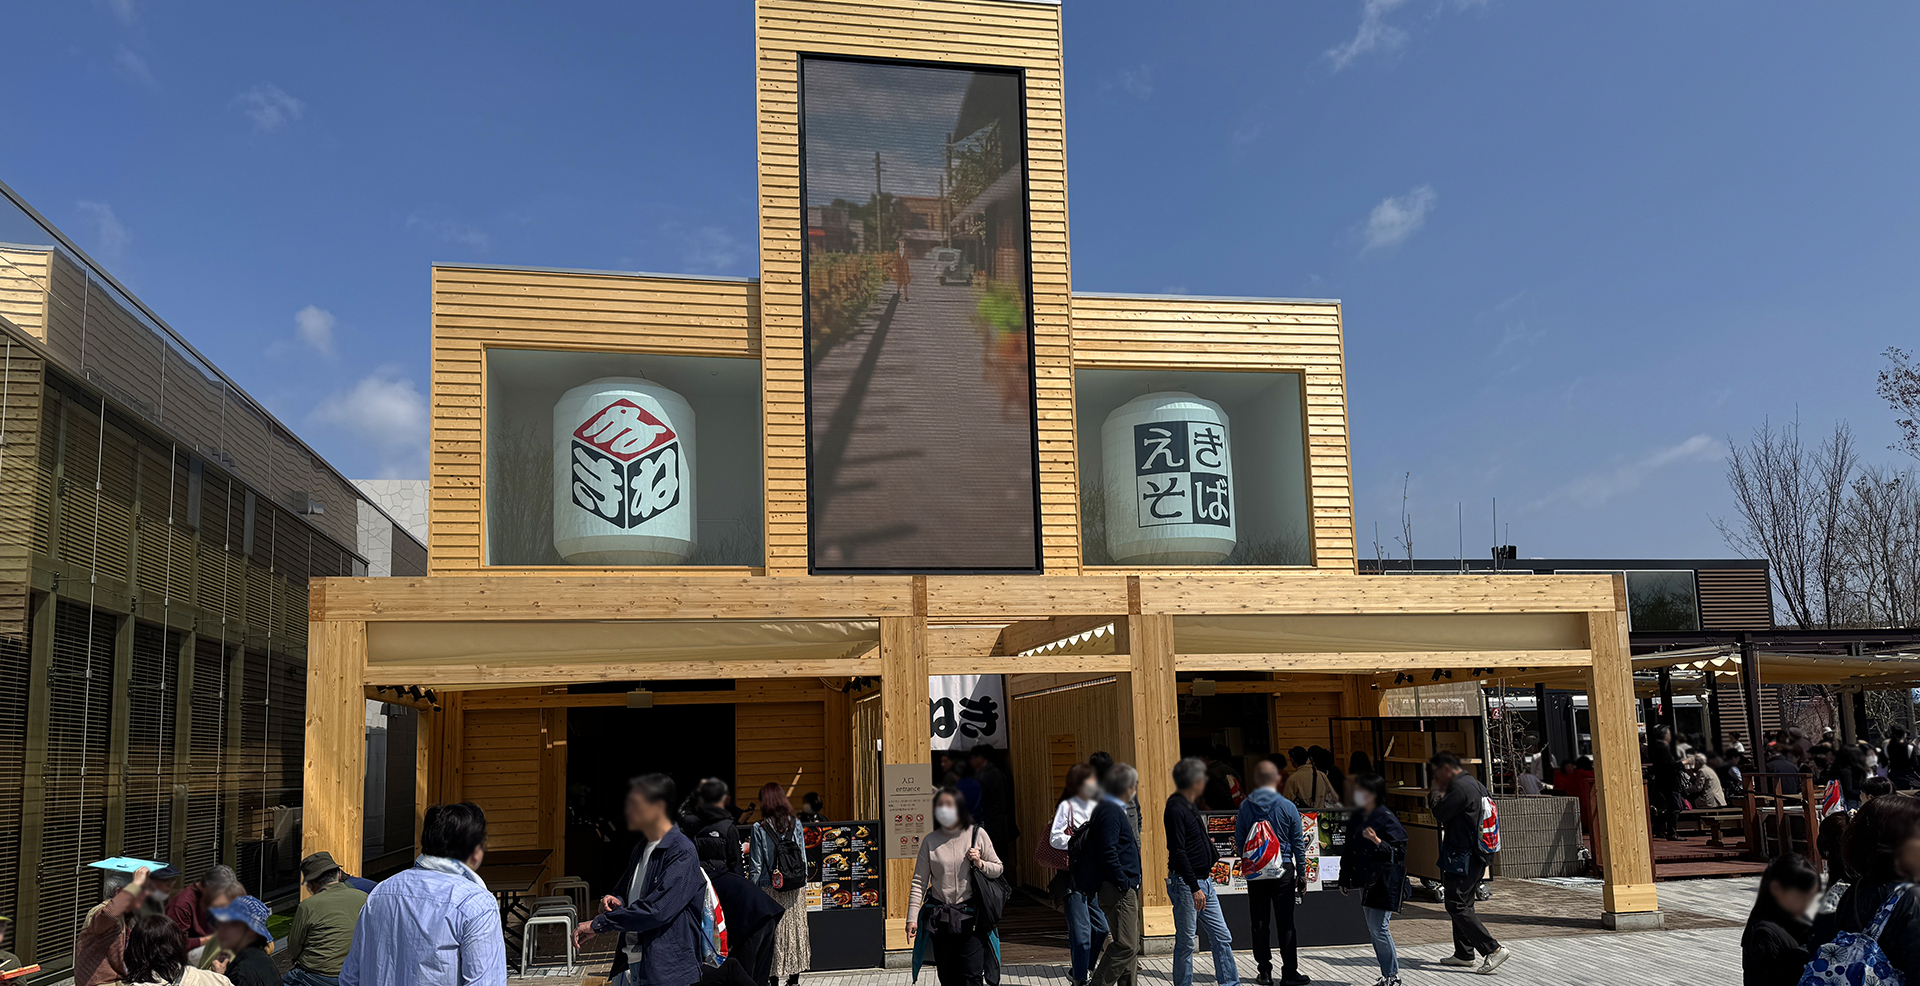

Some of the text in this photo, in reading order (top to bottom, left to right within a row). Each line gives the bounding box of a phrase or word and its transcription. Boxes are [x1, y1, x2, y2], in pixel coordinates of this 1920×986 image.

[1141, 427, 1223, 470] えき
[1143, 477, 1229, 521] そば
[902, 777, 914, 785] 入口
